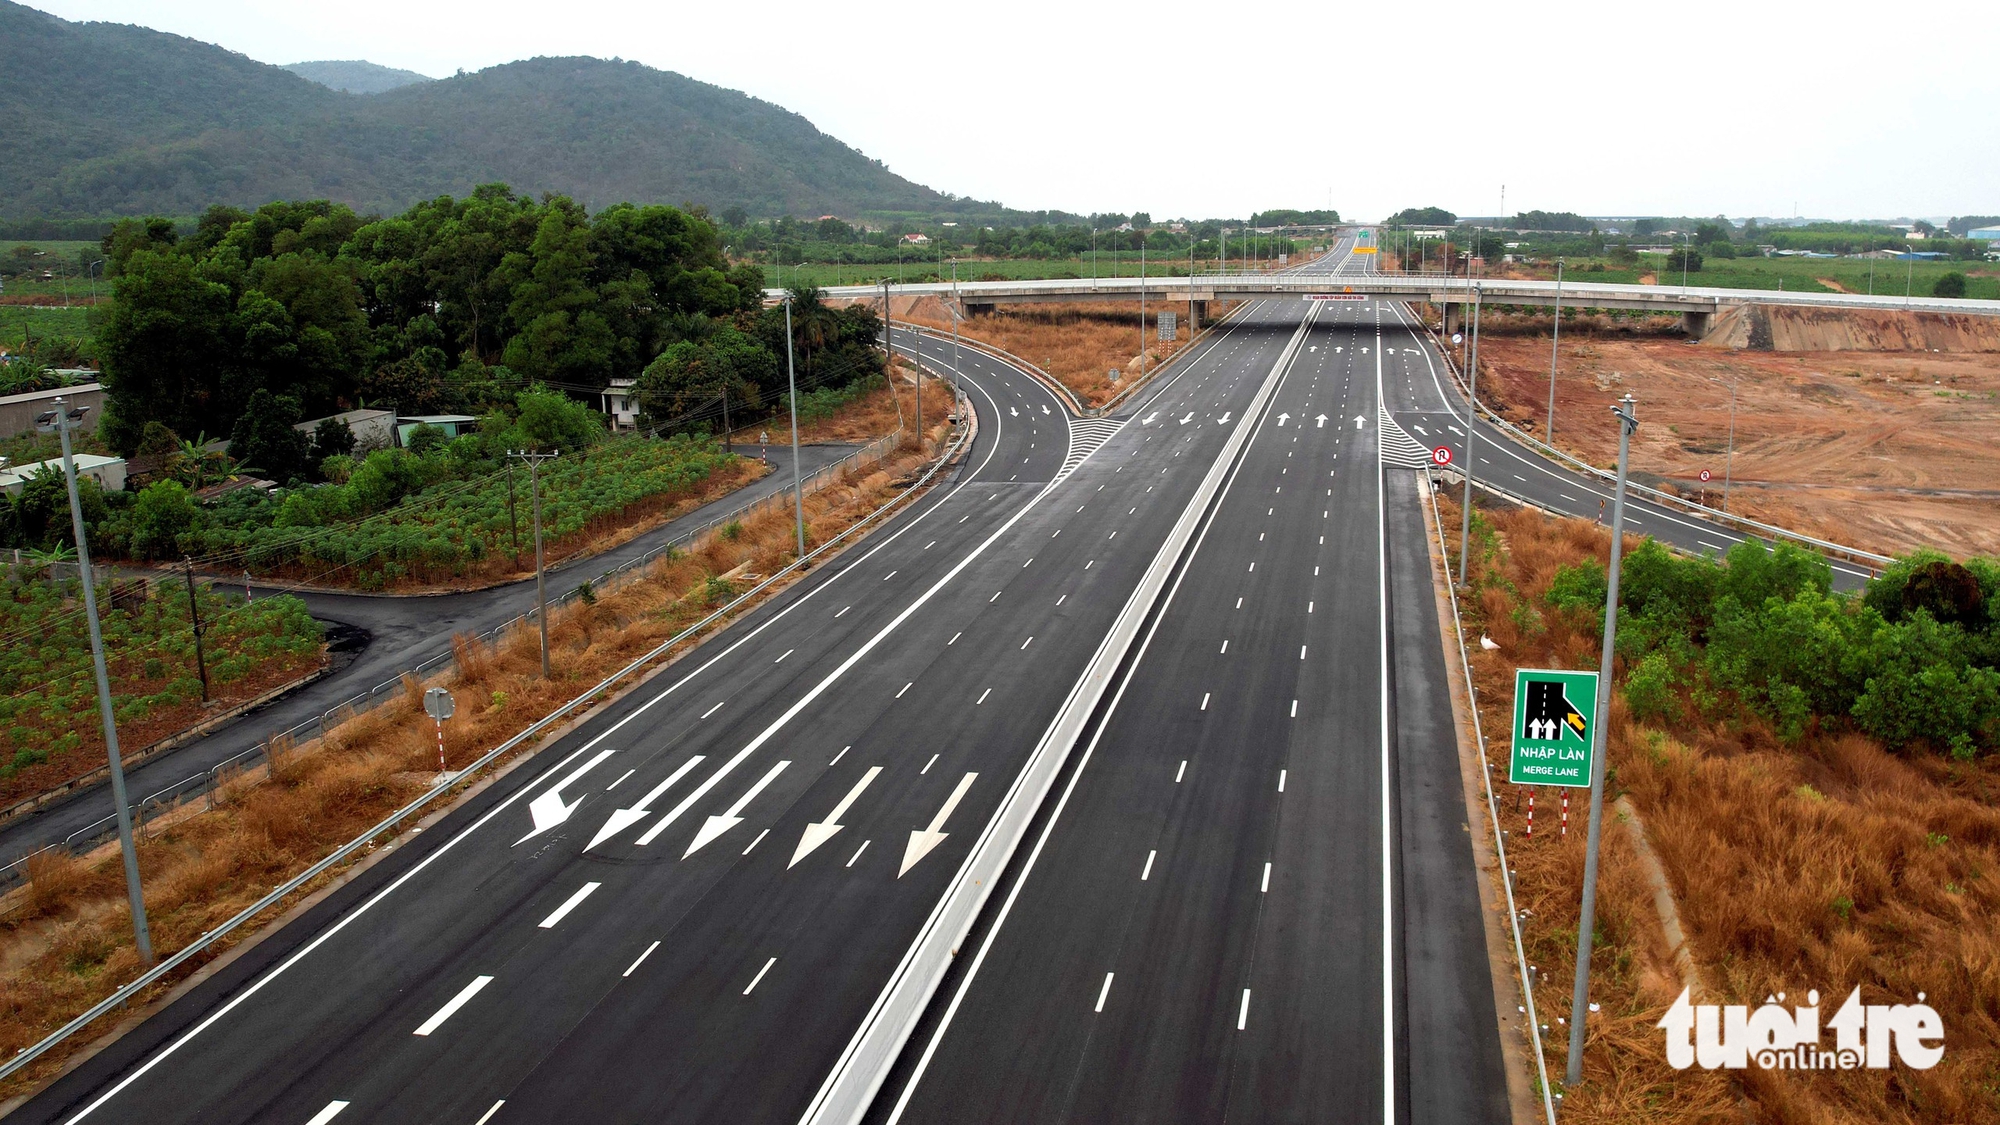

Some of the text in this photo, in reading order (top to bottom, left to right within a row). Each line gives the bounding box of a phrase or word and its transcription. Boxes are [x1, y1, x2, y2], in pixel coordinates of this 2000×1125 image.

[1520, 746, 1585, 761] NHẬP LÀN
[1522, 765, 1579, 777] MERGE LANE
